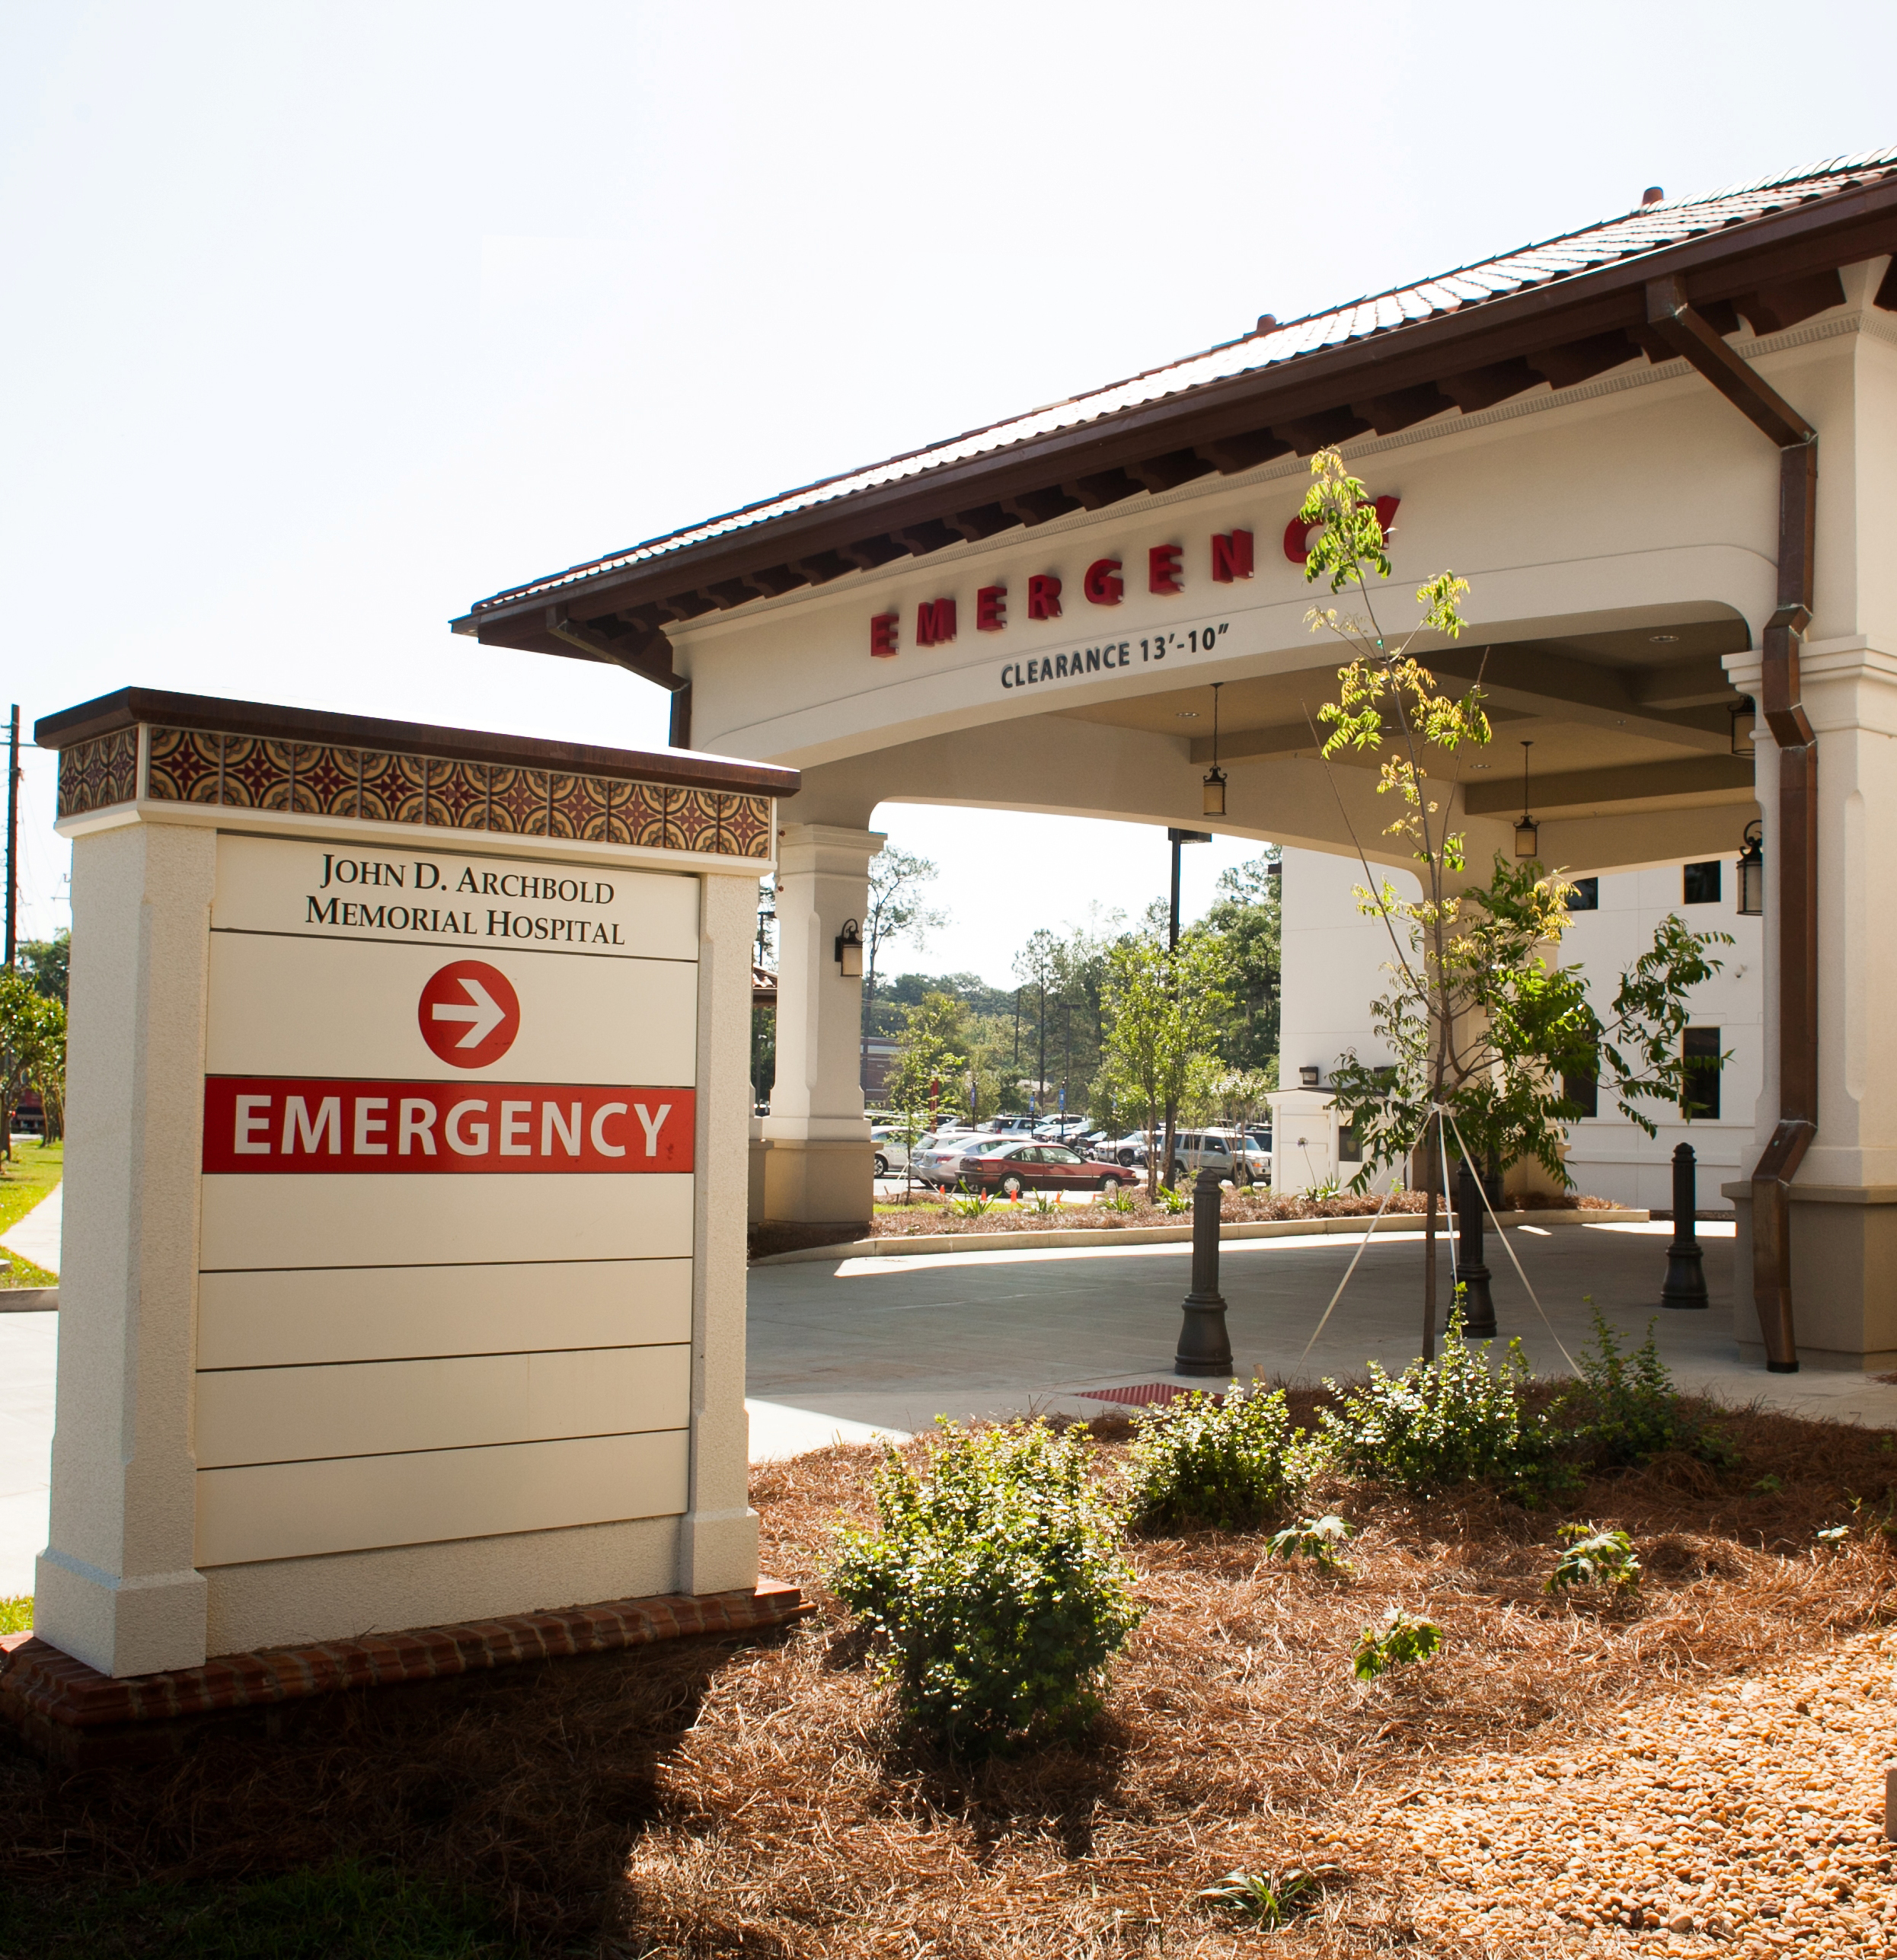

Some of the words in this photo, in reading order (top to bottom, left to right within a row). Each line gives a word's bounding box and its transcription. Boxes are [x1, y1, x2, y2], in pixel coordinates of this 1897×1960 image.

[1001, 642, 1130, 688] CLEARANCE
[320, 854, 406, 889] JOHN
[414, 862, 448, 891] D.
[455, 867, 615, 905] ARCHBOLD
[305, 895, 478, 936] MEMORIAL
[485, 910, 626, 946] HOSPITAL
[233, 1093, 672, 1158] EMERGENCY
